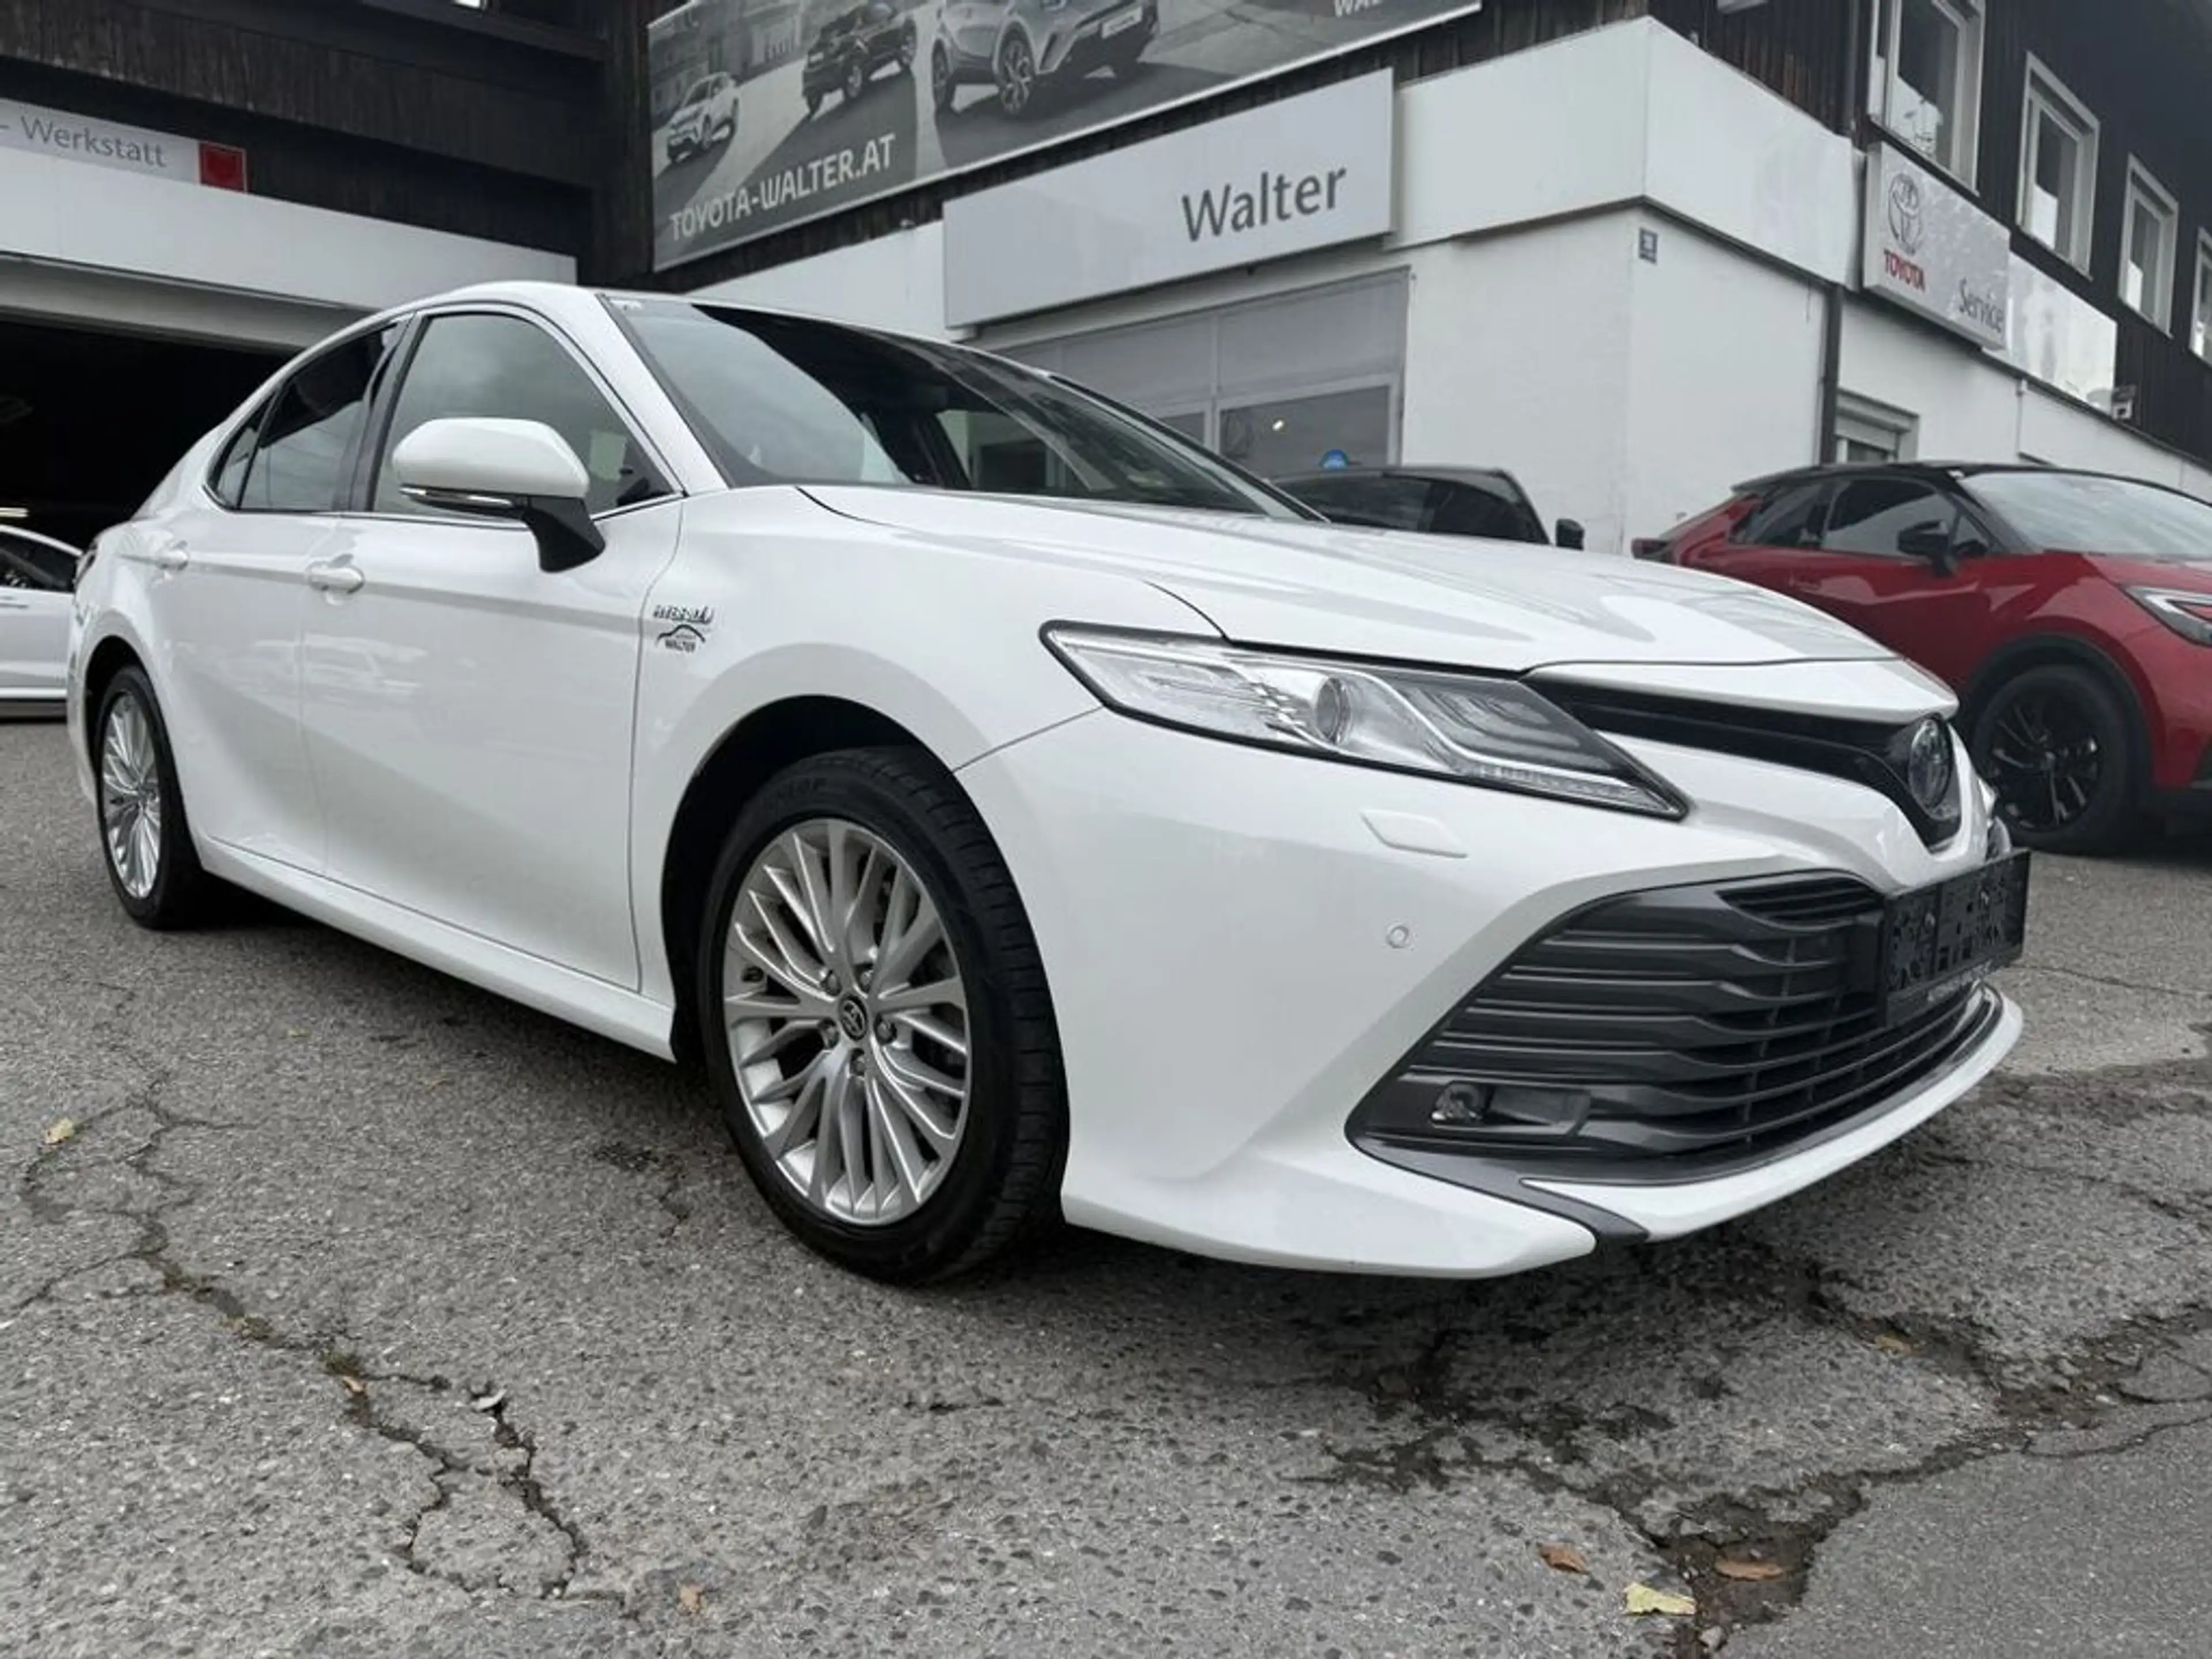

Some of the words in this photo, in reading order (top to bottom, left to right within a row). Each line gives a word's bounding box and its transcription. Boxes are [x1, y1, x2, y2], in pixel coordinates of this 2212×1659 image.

[21, 115, 167, 167] Werkstatt
[669, 133, 896, 240] TOYOTA-WALTER.AT
[1182, 168, 1347, 242] Walter
[1884, 248, 1925, 292] TOYOTA
[1959, 276, 2004, 333] Service
